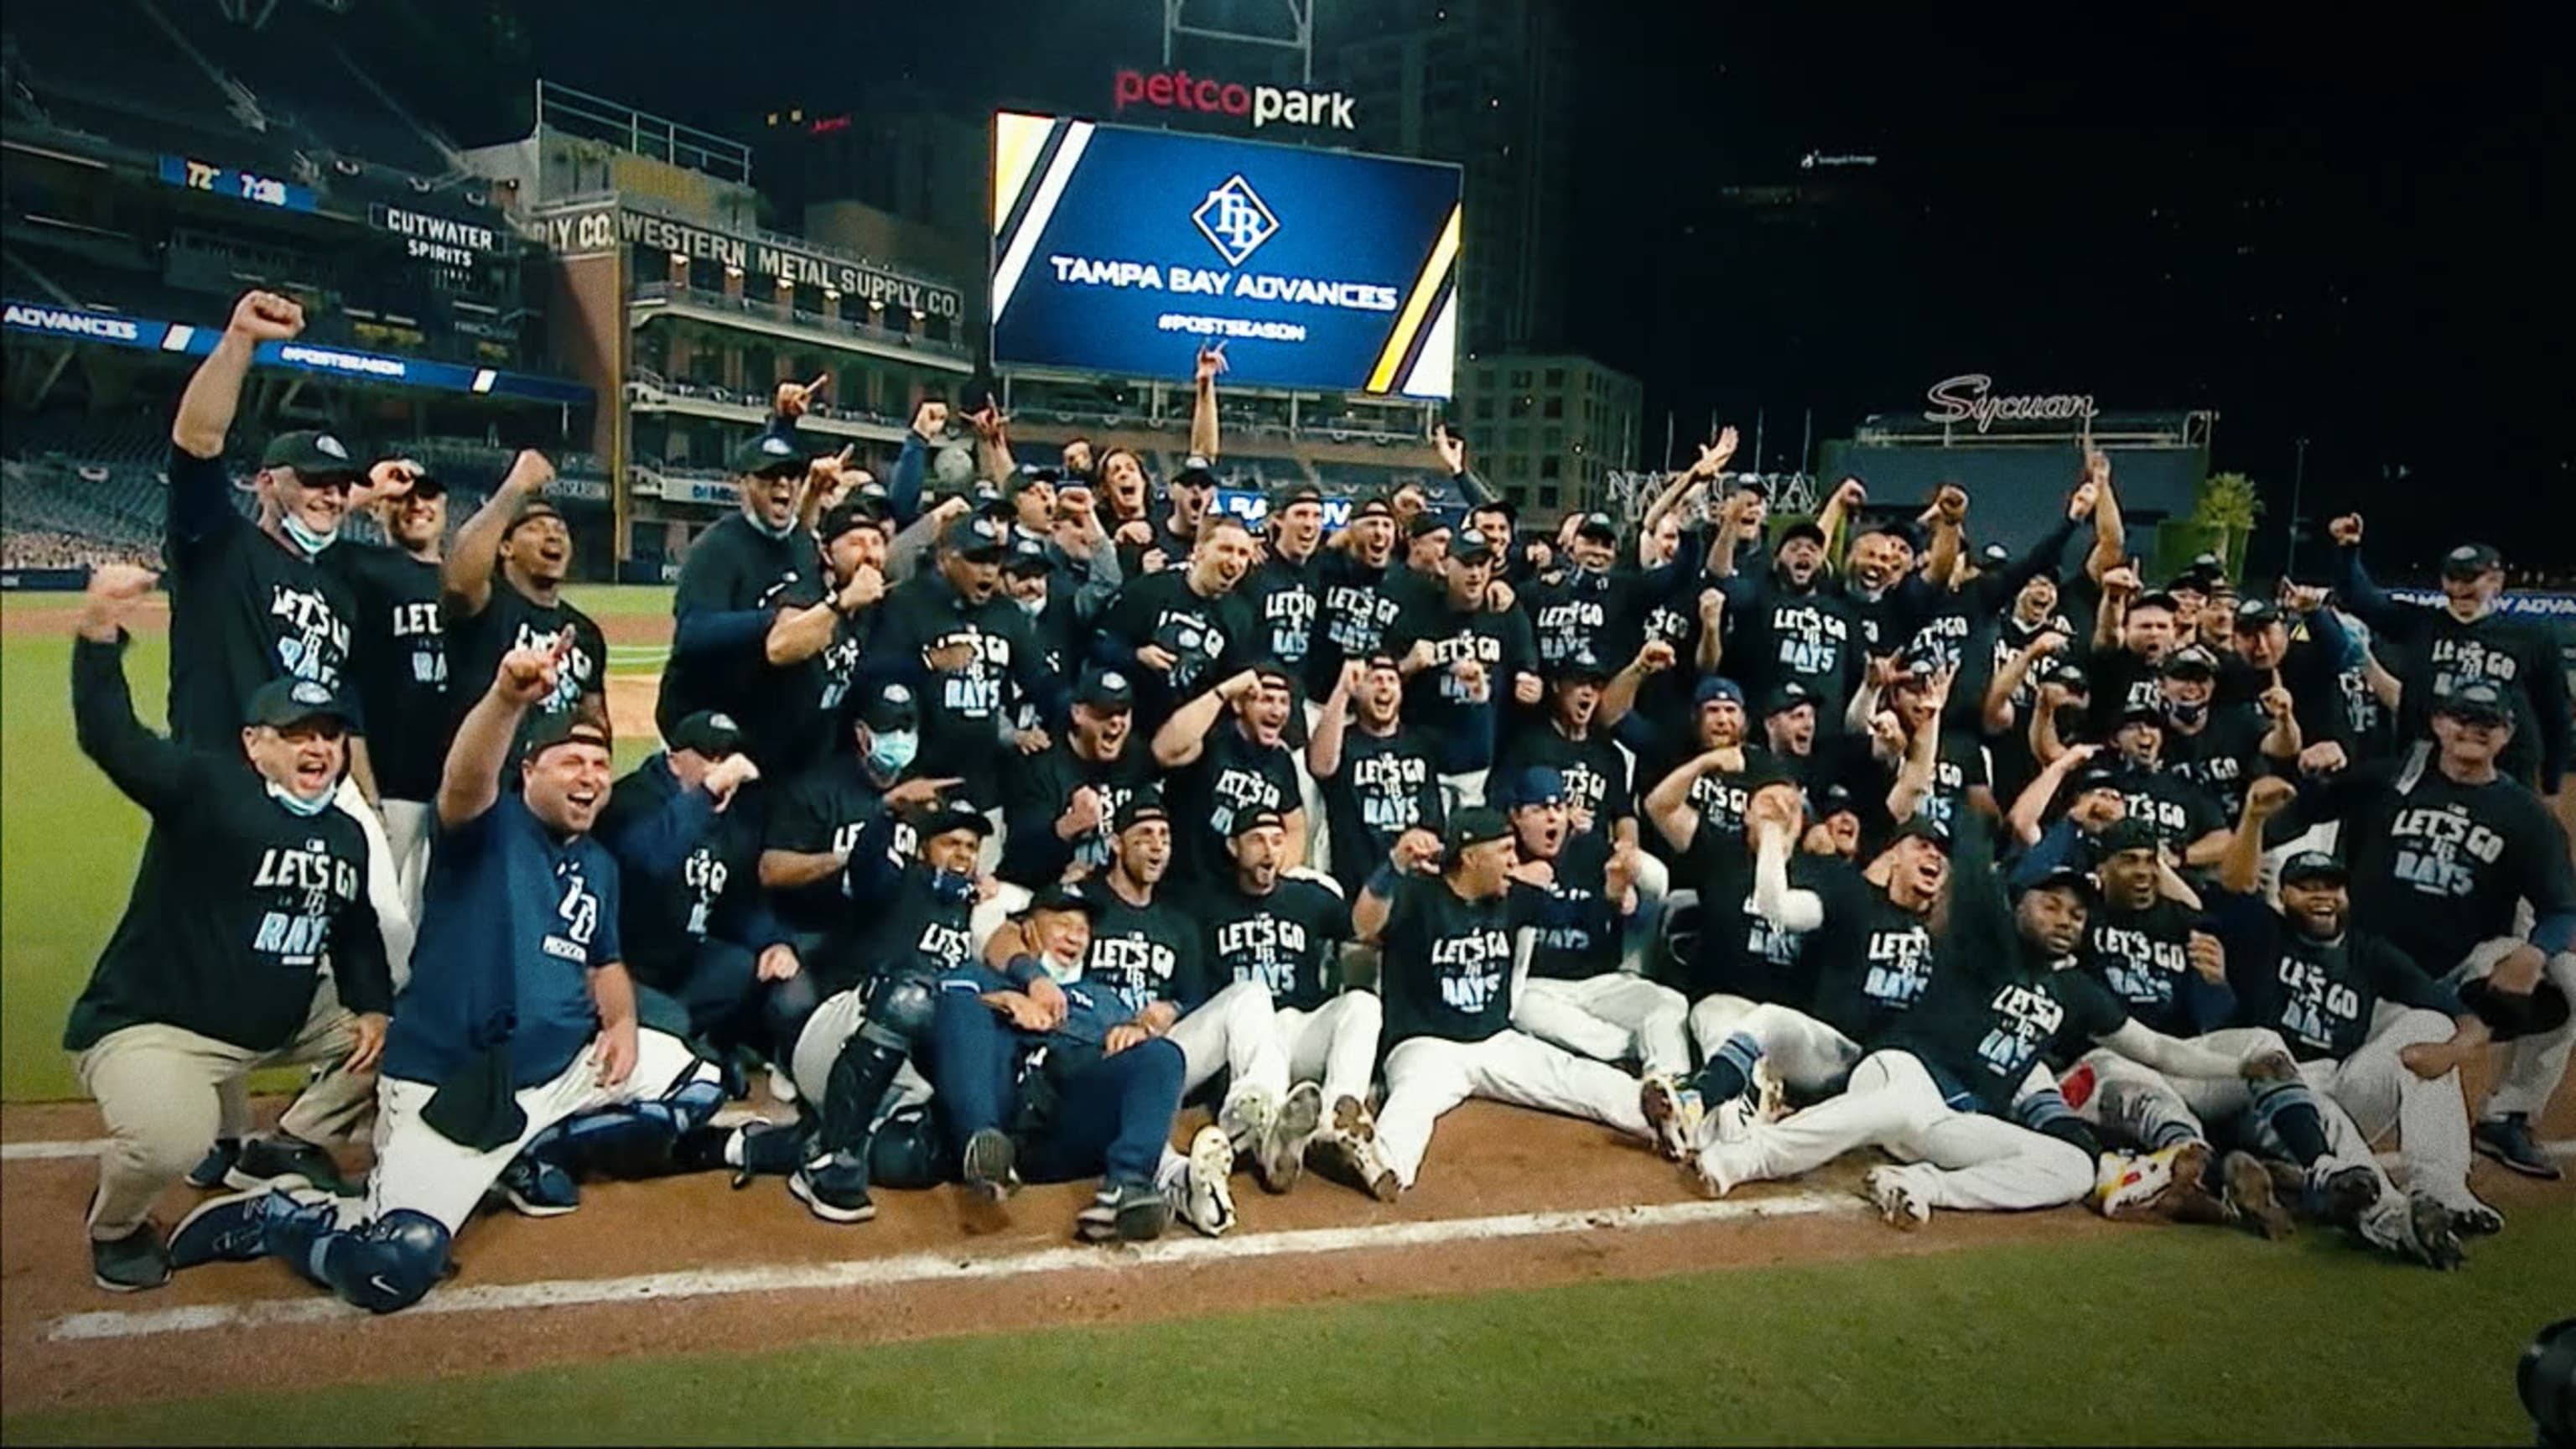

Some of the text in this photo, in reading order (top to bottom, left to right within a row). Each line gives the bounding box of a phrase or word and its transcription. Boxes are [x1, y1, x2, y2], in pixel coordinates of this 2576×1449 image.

[387, 208, 493, 252] CUTWATER
[579, 212, 615, 248] CO.
[407, 239, 473, 267] SPIRITS
[621, 210, 962, 322] WESTERN METAL SUPPLY CO.
[1050, 254, 1399, 312] TAMPA BAY ADVANCES
[3, 304, 138, 340] ADVANCES
[1158, 313, 1307, 342] #POSTSEASON
[1923, 374, 2100, 434] Sycuan
[1327, 586, 1375, 617] LET'S
[1538, 600, 1581, 627] LET'S
[1774, 606, 1821, 631] LET'S
[393, 602, 444, 637] LET
[1779, 639, 1837, 672] RAYS
[2485, 651, 2516, 680] GO
[945, 678, 1001, 709] RAYS
[1354, 756, 1402, 787] LET'S
[1362, 797, 1420, 825] RAYS
[2158, 801, 2186, 830] GO
[2391, 808, 2506, 865] LET'S GO
[253, 849, 330, 888] LET'S
[2394, 849, 2475, 897] RAYS
[1091, 936, 1150, 971] LET'S
[1218, 918, 1306, 956] LET'S GO
[1432, 932, 1486, 965] LET'S
[2094, 926, 2187, 974] LET'S GO
[1440, 974, 1501, 1008] RAYS
[2326, 981, 2360, 1021] GO
